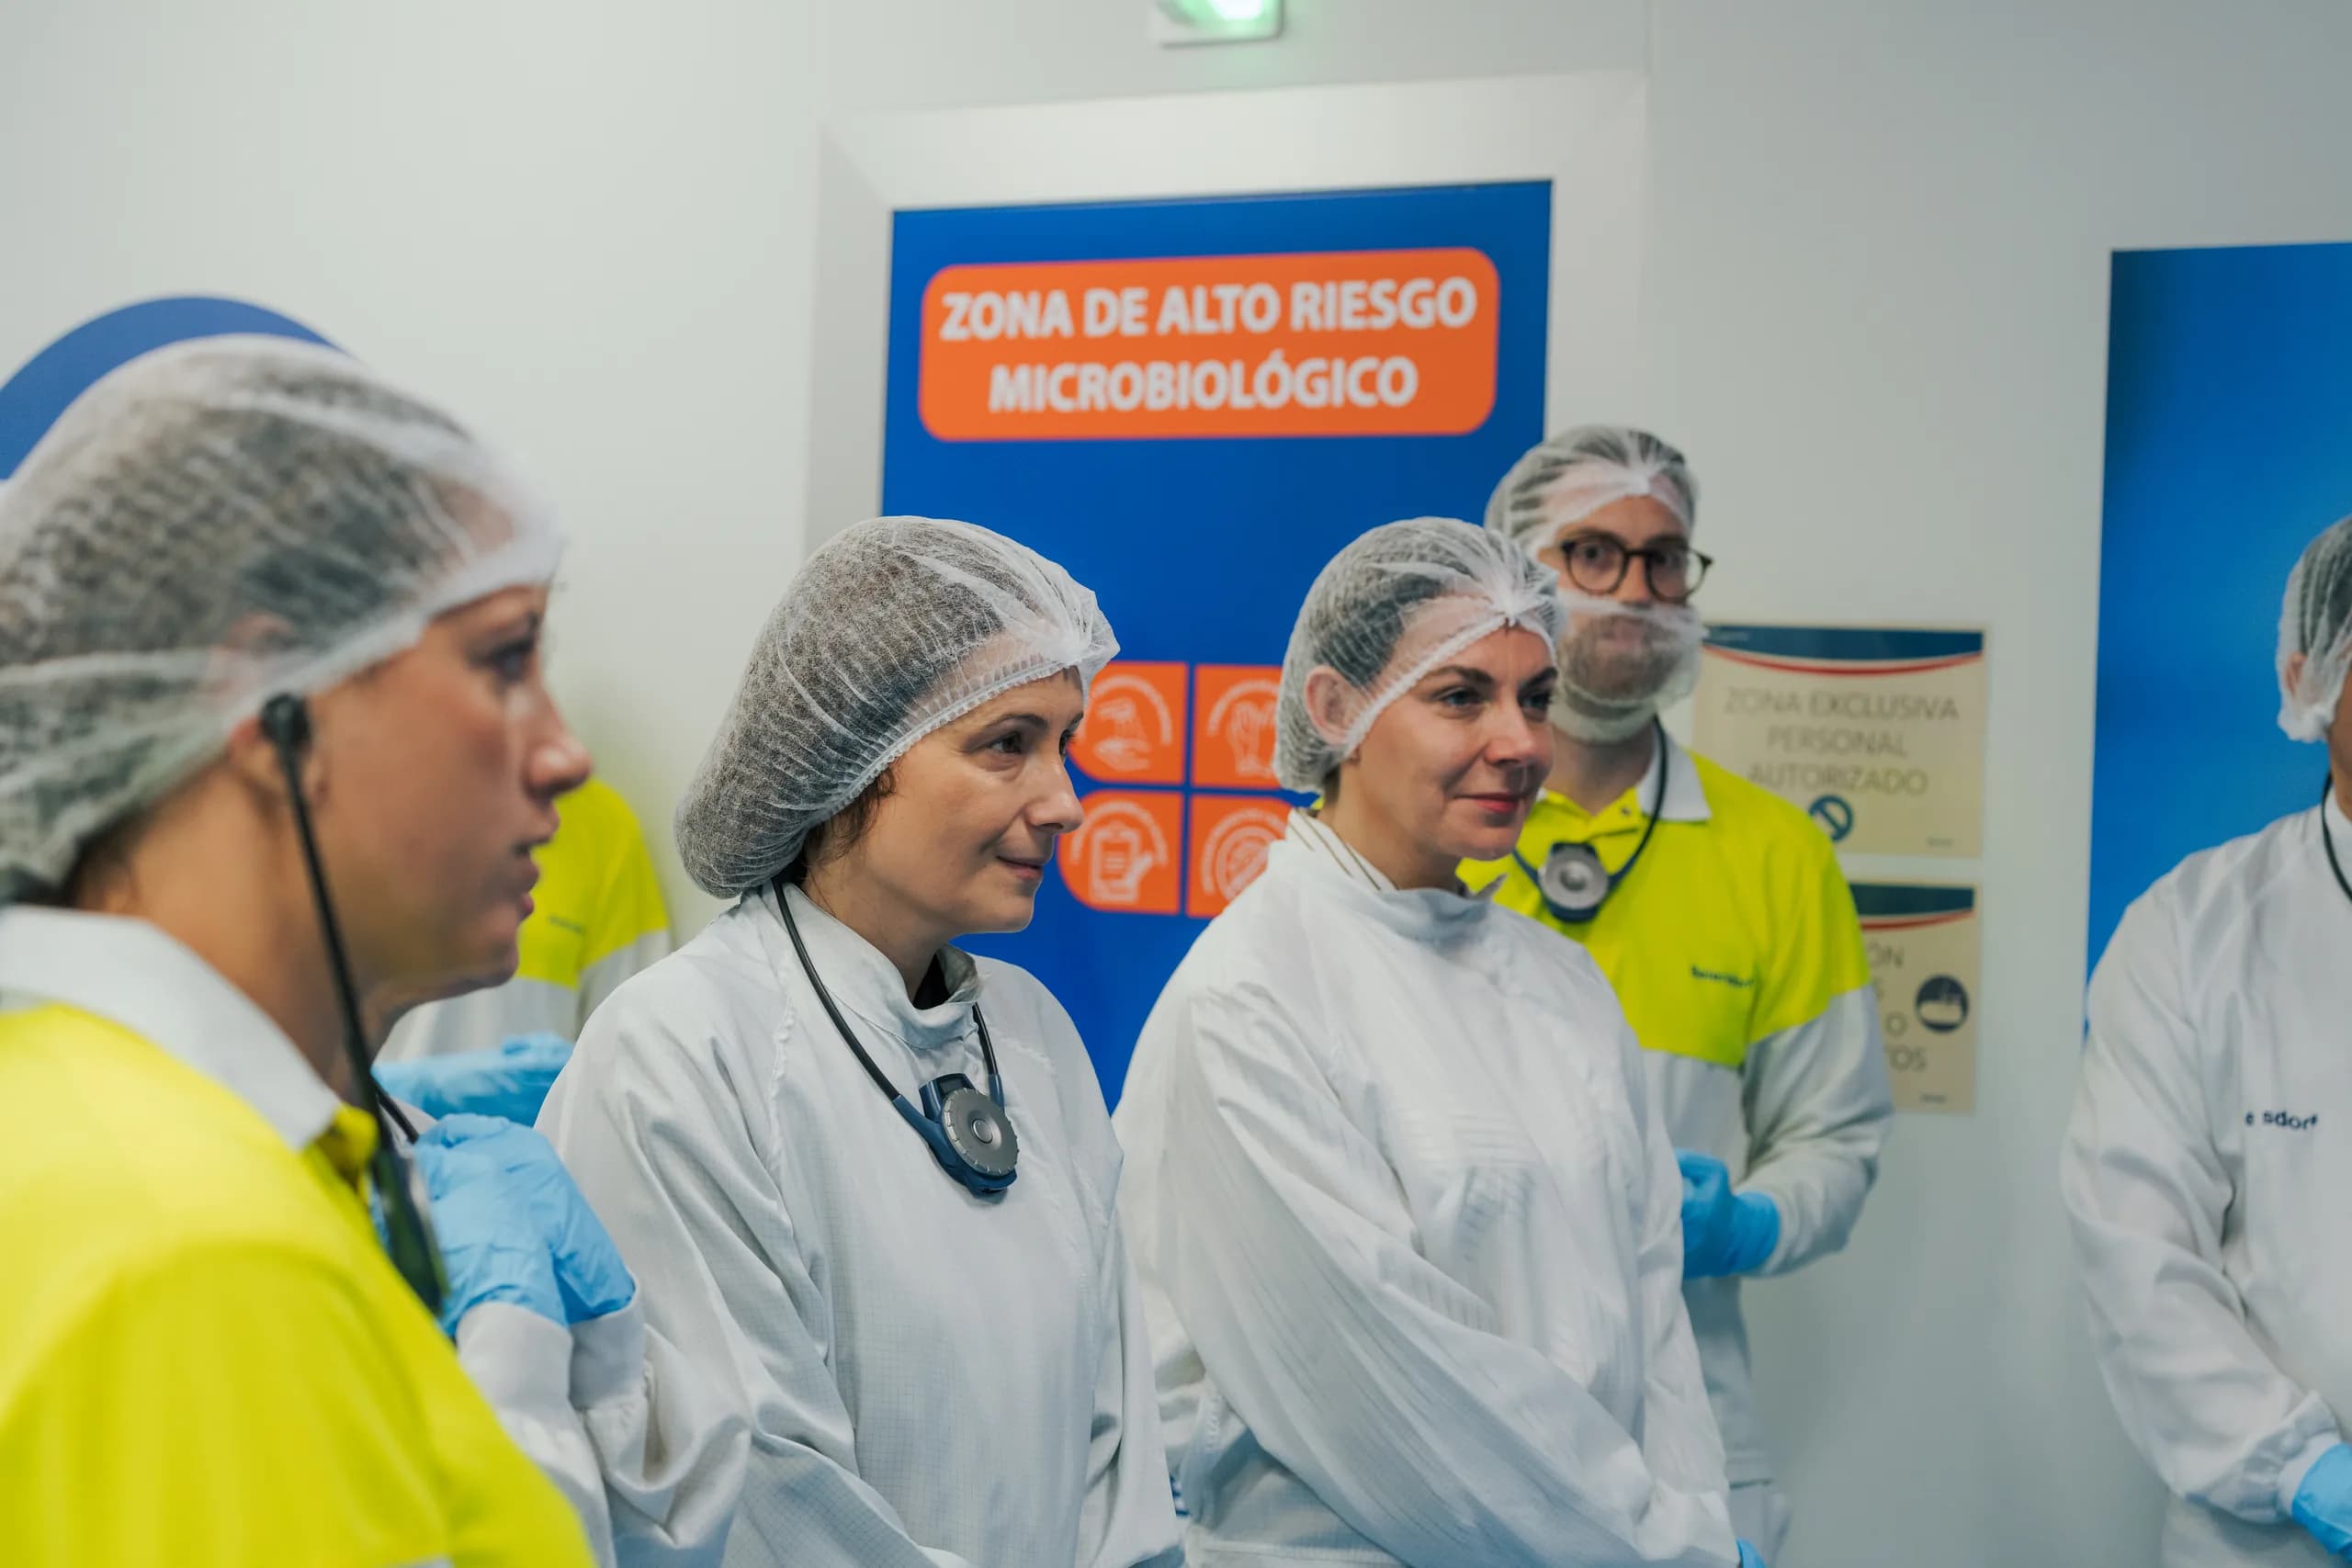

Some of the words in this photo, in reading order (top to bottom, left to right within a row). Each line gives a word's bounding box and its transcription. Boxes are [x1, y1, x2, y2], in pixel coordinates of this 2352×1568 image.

[939, 289, 1075, 341] ZONA
[1082, 287, 1149, 336] DE
[1156, 283, 1282, 335] ALTO
[1290, 276, 1477, 331] RIESGO
[988, 348, 1419, 413] MICROBIOLÓGICO
[1724, 686, 1801, 714] ZONA
[1808, 691, 1960, 720] EXCLUSIVA
[1766, 726, 1908, 758] PERSONAL
[1747, 762, 1928, 796] AUTORIZADO
